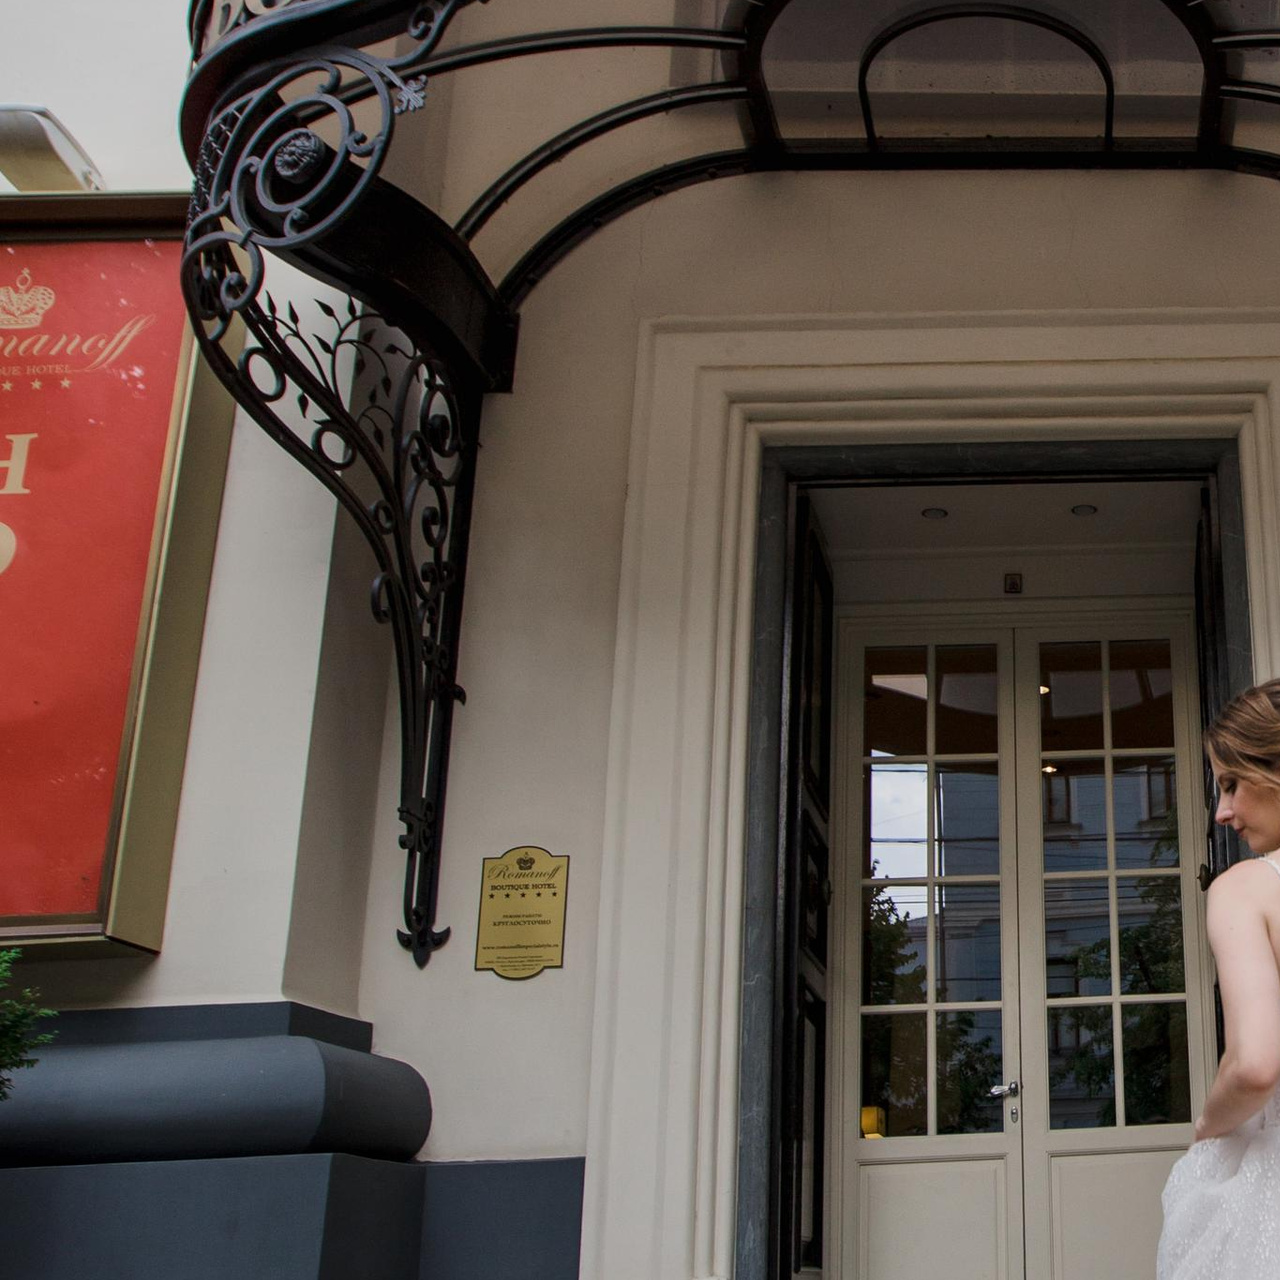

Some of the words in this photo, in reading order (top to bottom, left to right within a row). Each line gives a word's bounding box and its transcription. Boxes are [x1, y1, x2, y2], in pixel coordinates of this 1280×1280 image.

[487, 863, 562, 881] Romanoff
[490, 883, 530, 892] BOUTIQUE
[531, 883, 557, 891] HOTEL
